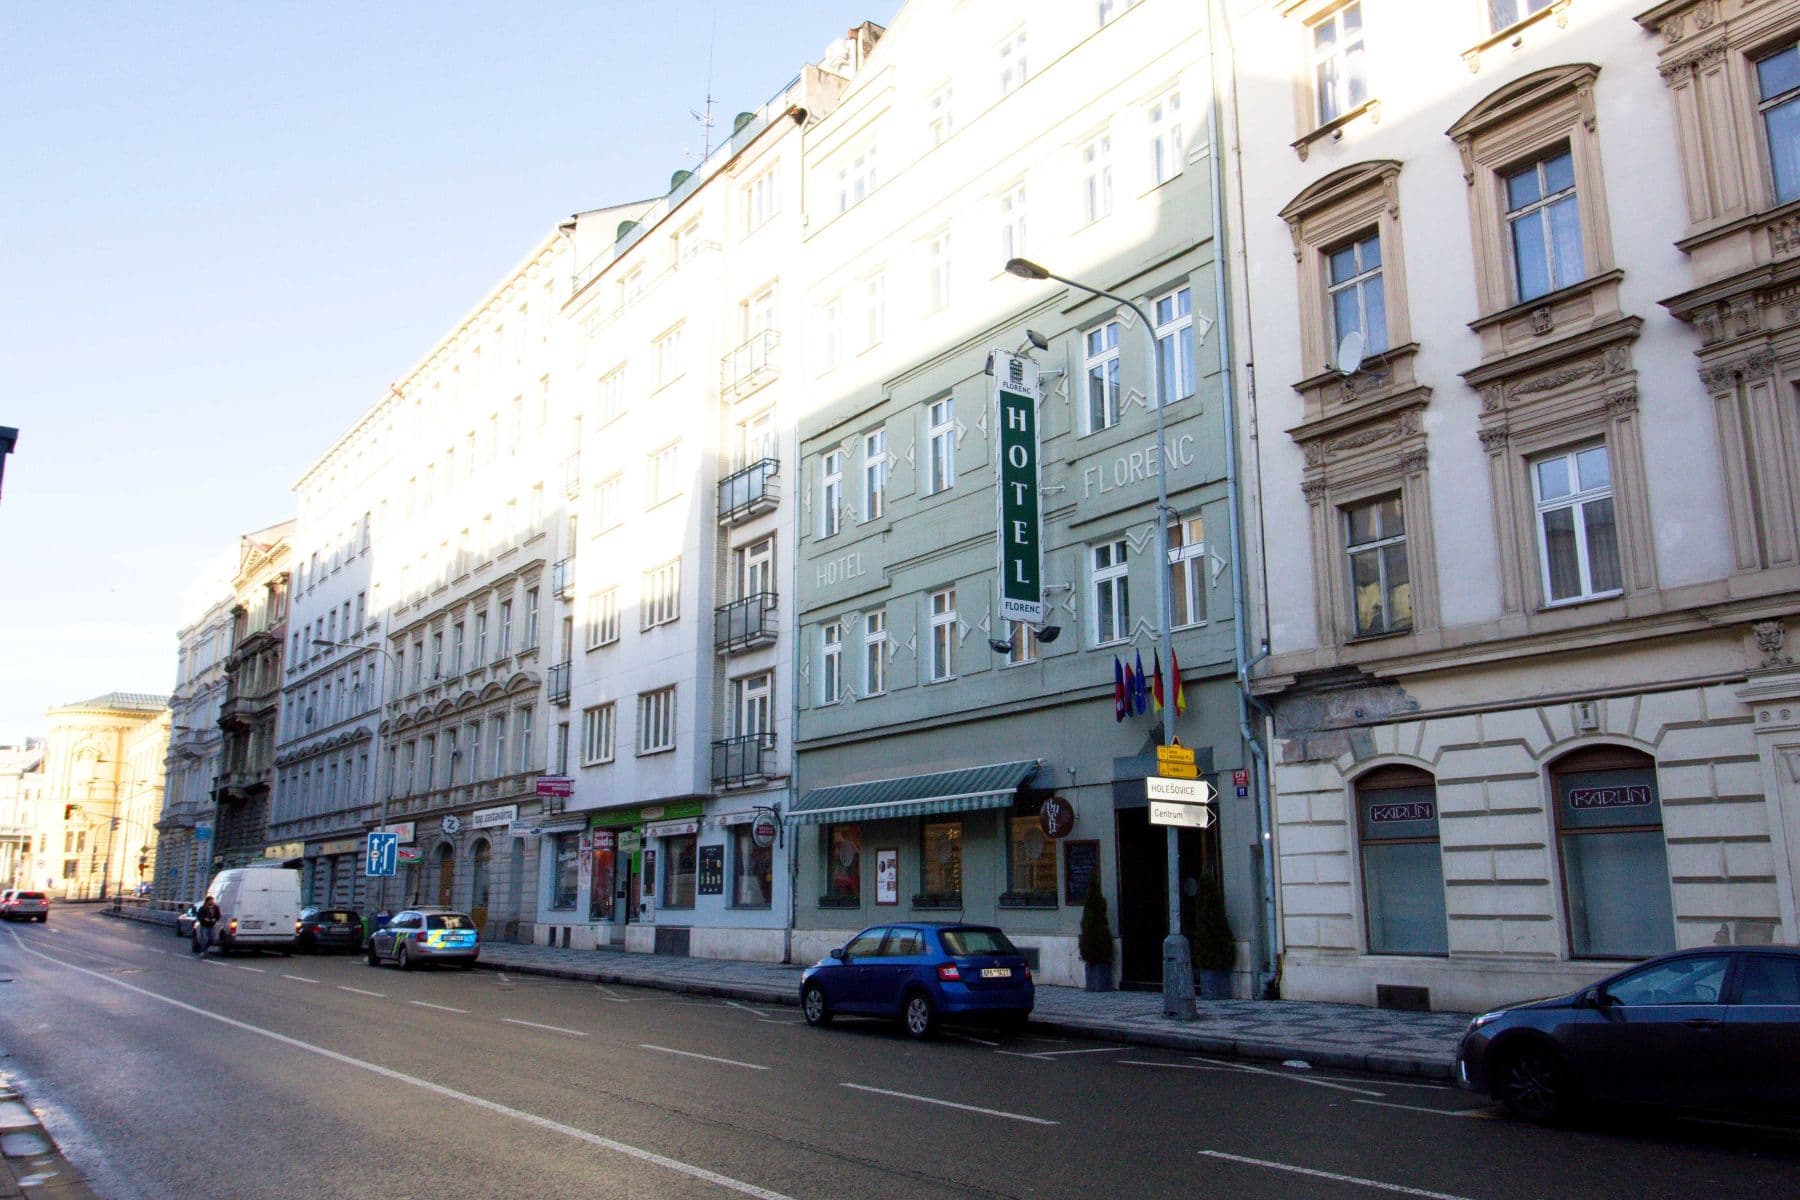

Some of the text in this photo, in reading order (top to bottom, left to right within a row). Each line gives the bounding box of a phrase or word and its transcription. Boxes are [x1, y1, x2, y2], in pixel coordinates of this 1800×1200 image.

[1002, 381, 1031, 394] FLORENC
[1084, 434, 1194, 500] FLORENC
[1006, 406, 1030, 584] HOTEL
[816, 551, 867, 588] HOTEL
[1005, 601, 1041, 614] FLORENC
[1151, 784, 1196, 796] HOLEŠOVICE
[1154, 808, 1184, 820] Centrum
